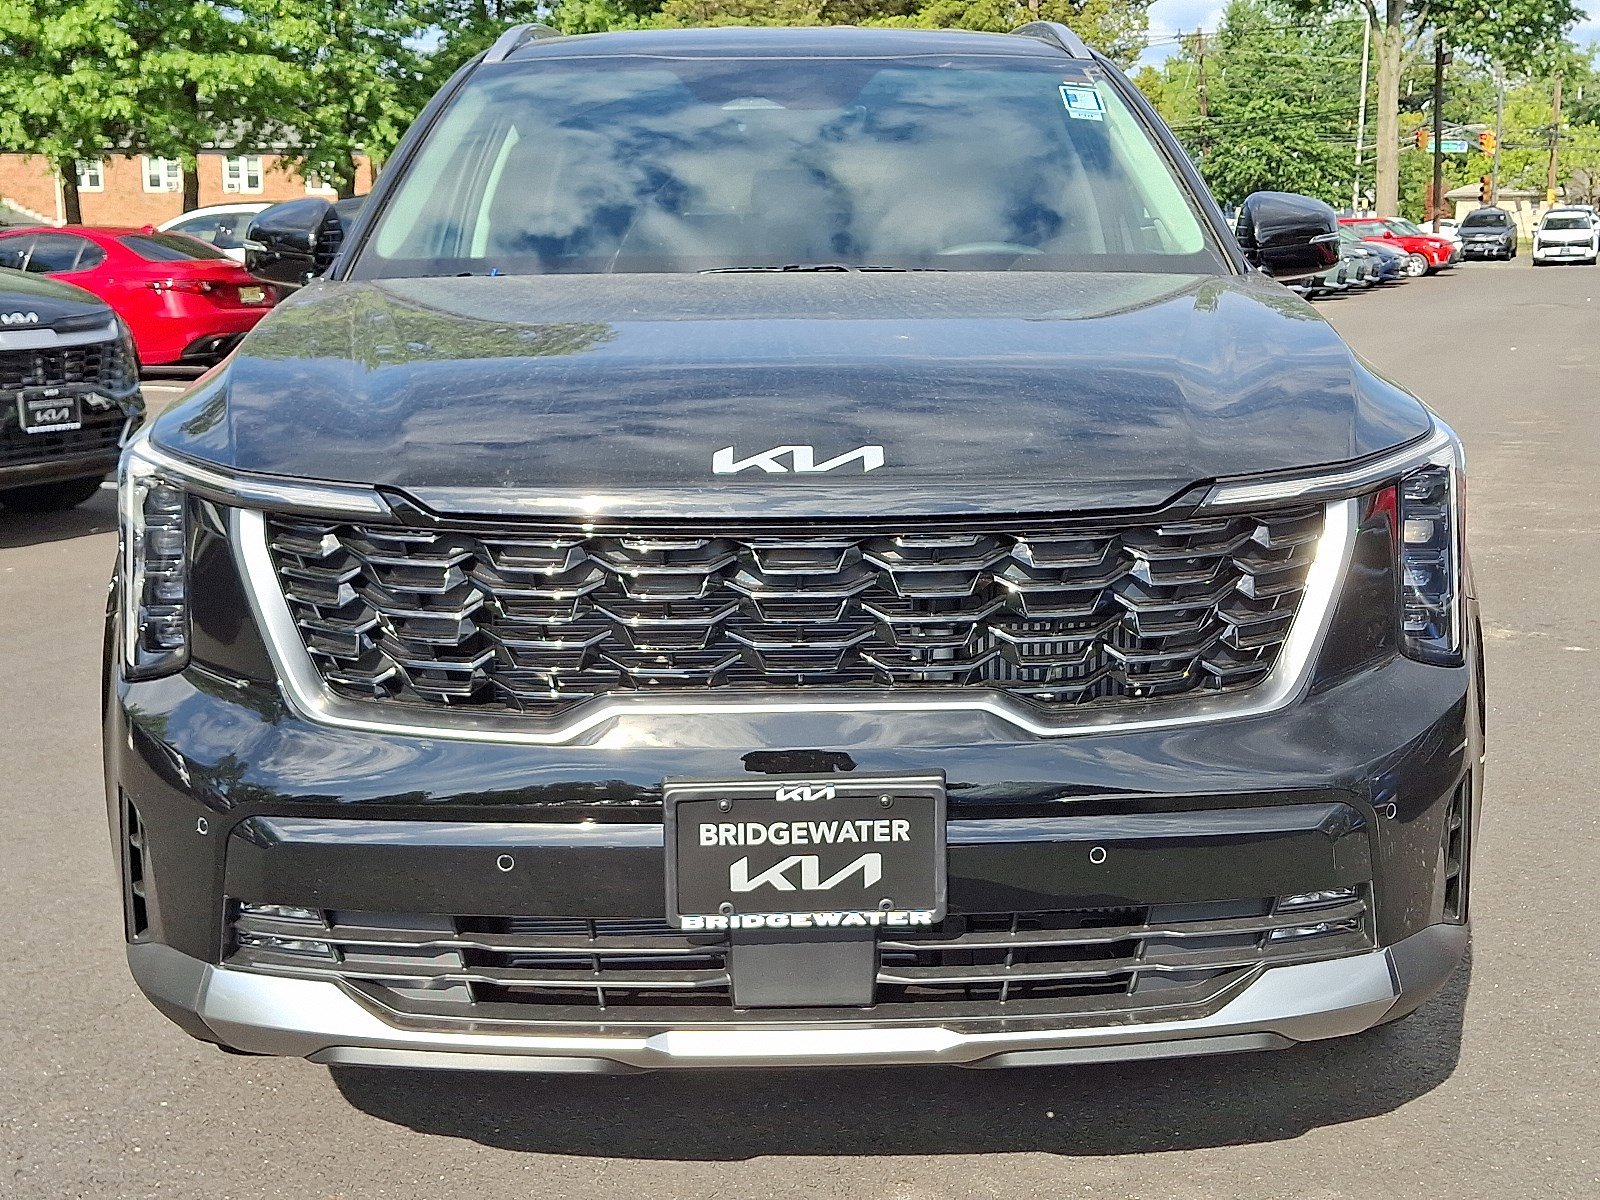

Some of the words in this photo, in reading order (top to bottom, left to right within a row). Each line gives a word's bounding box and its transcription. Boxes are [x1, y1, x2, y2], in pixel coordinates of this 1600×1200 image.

[712, 444, 884, 474] KIA
[776, 783, 836, 801] KIA
[699, 819, 911, 846] BRIDGEWATER
[730, 852, 882, 892] KIA
[681, 911, 932, 930] BRIDGEWATER
